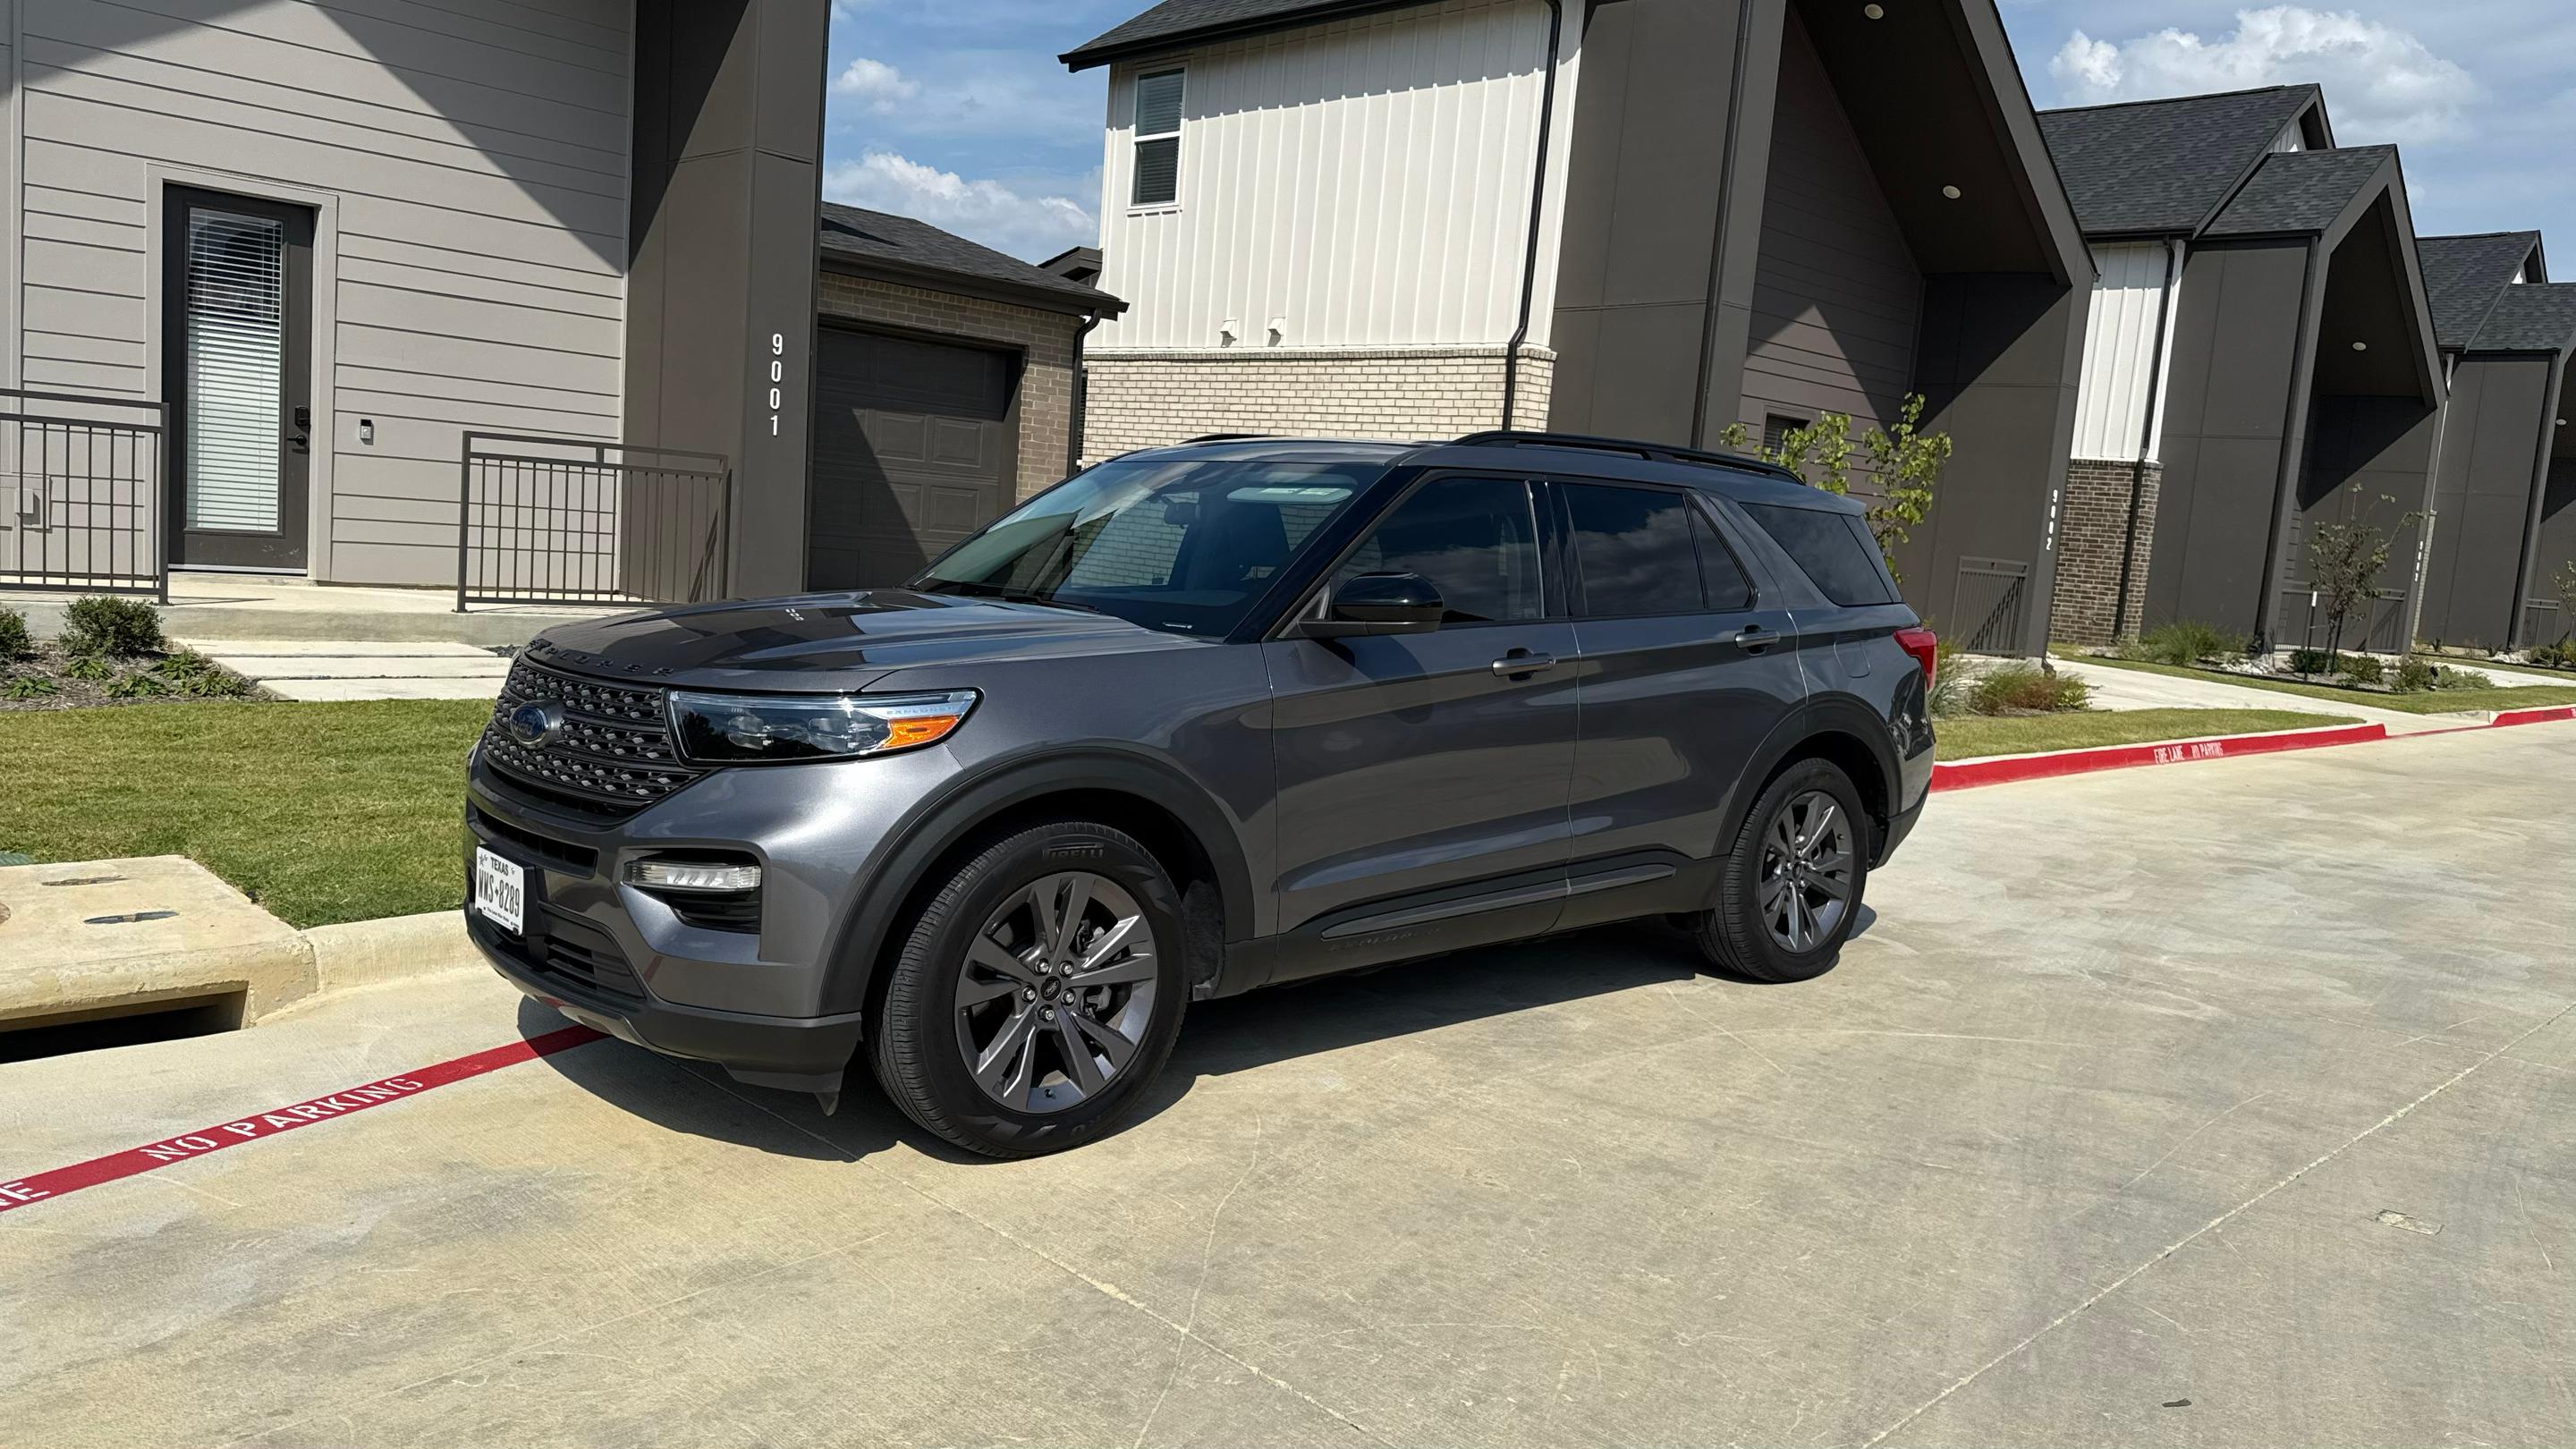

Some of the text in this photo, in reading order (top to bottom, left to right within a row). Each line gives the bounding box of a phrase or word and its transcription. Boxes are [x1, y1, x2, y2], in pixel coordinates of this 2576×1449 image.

[769, 333, 783, 436] 9001
[490, 856, 509, 877] TEXAS
[140, 1136, 217, 1162] NO
[223, 1078, 423, 1138] PARKING
